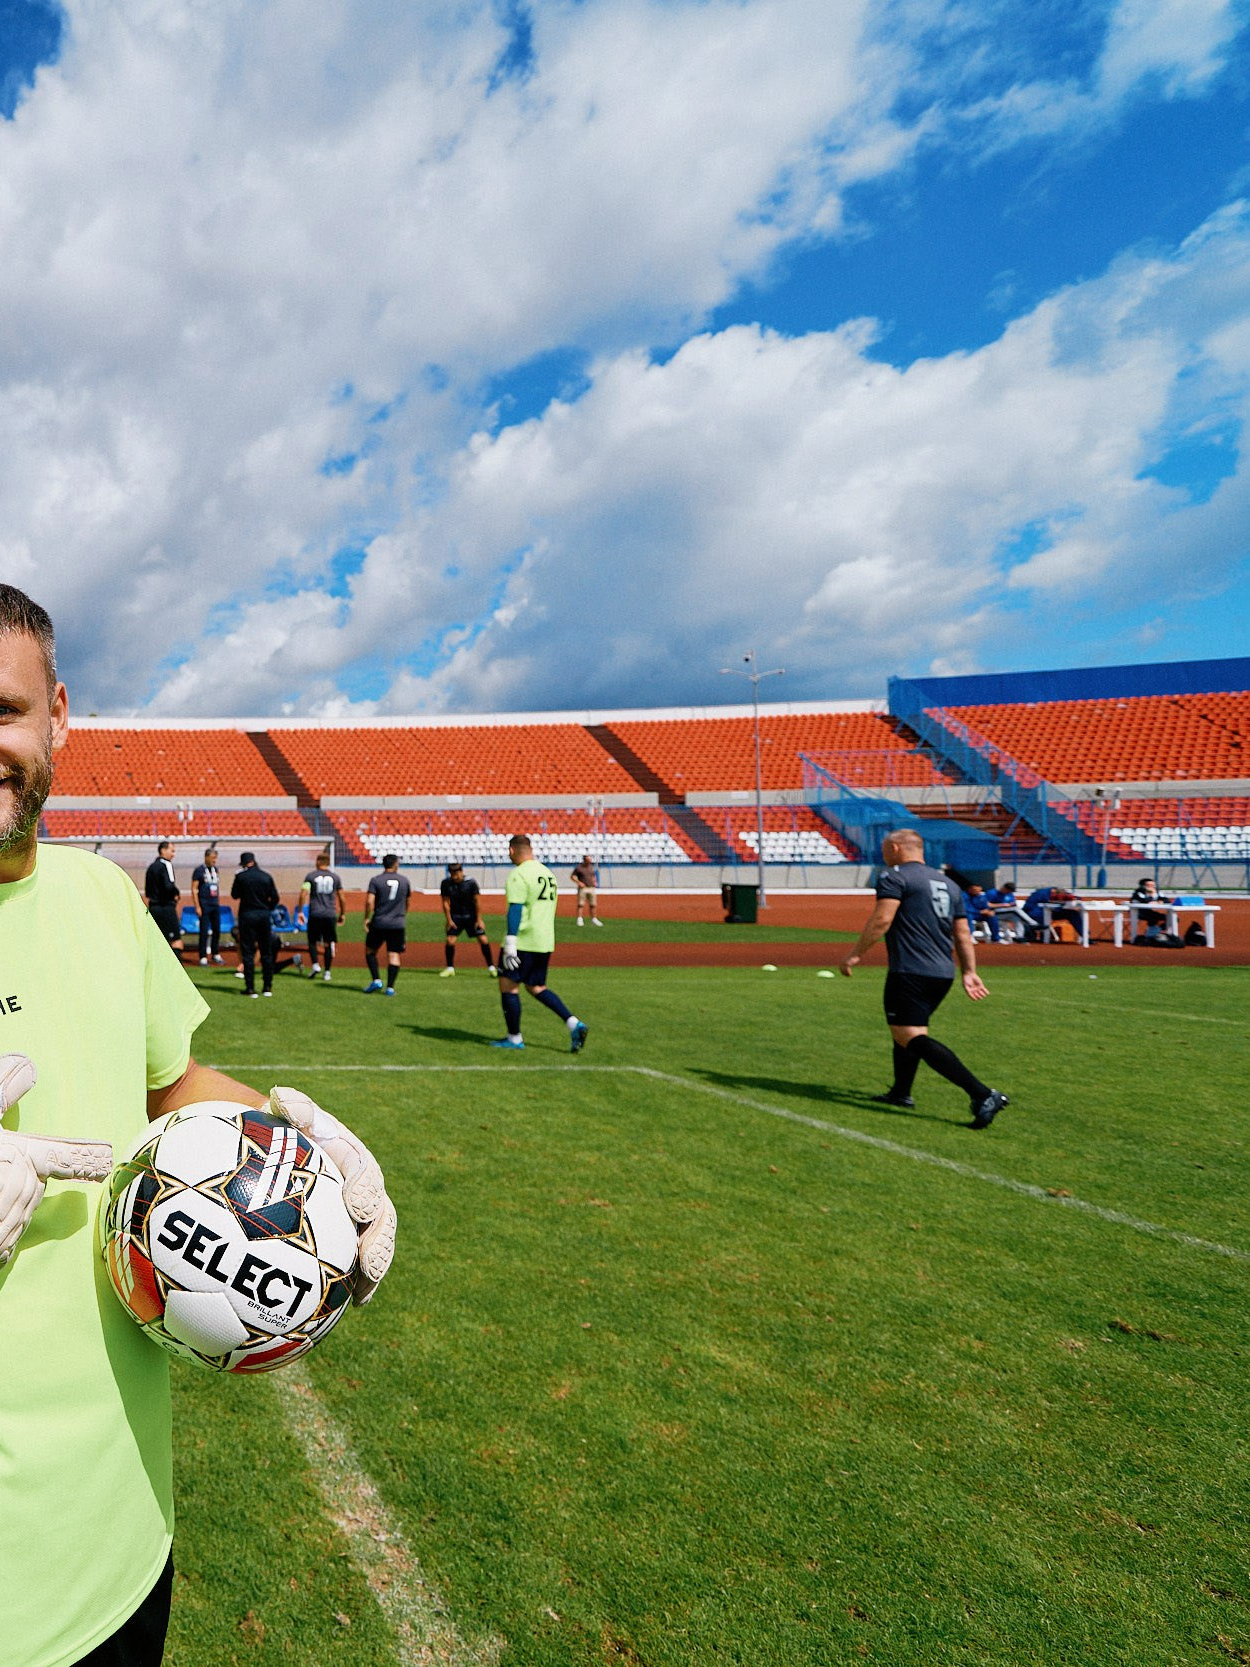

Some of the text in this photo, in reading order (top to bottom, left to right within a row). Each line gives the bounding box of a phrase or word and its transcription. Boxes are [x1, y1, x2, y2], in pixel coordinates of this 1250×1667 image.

[313, 875, 334, 895] 10
[386, 879, 400, 901] 7
[537, 876, 557, 901] 25
[156, 1209, 314, 1318] SELECT
[247, 1300, 291, 1324] BRILLANT
[257, 1313, 288, 1329] SUPER
